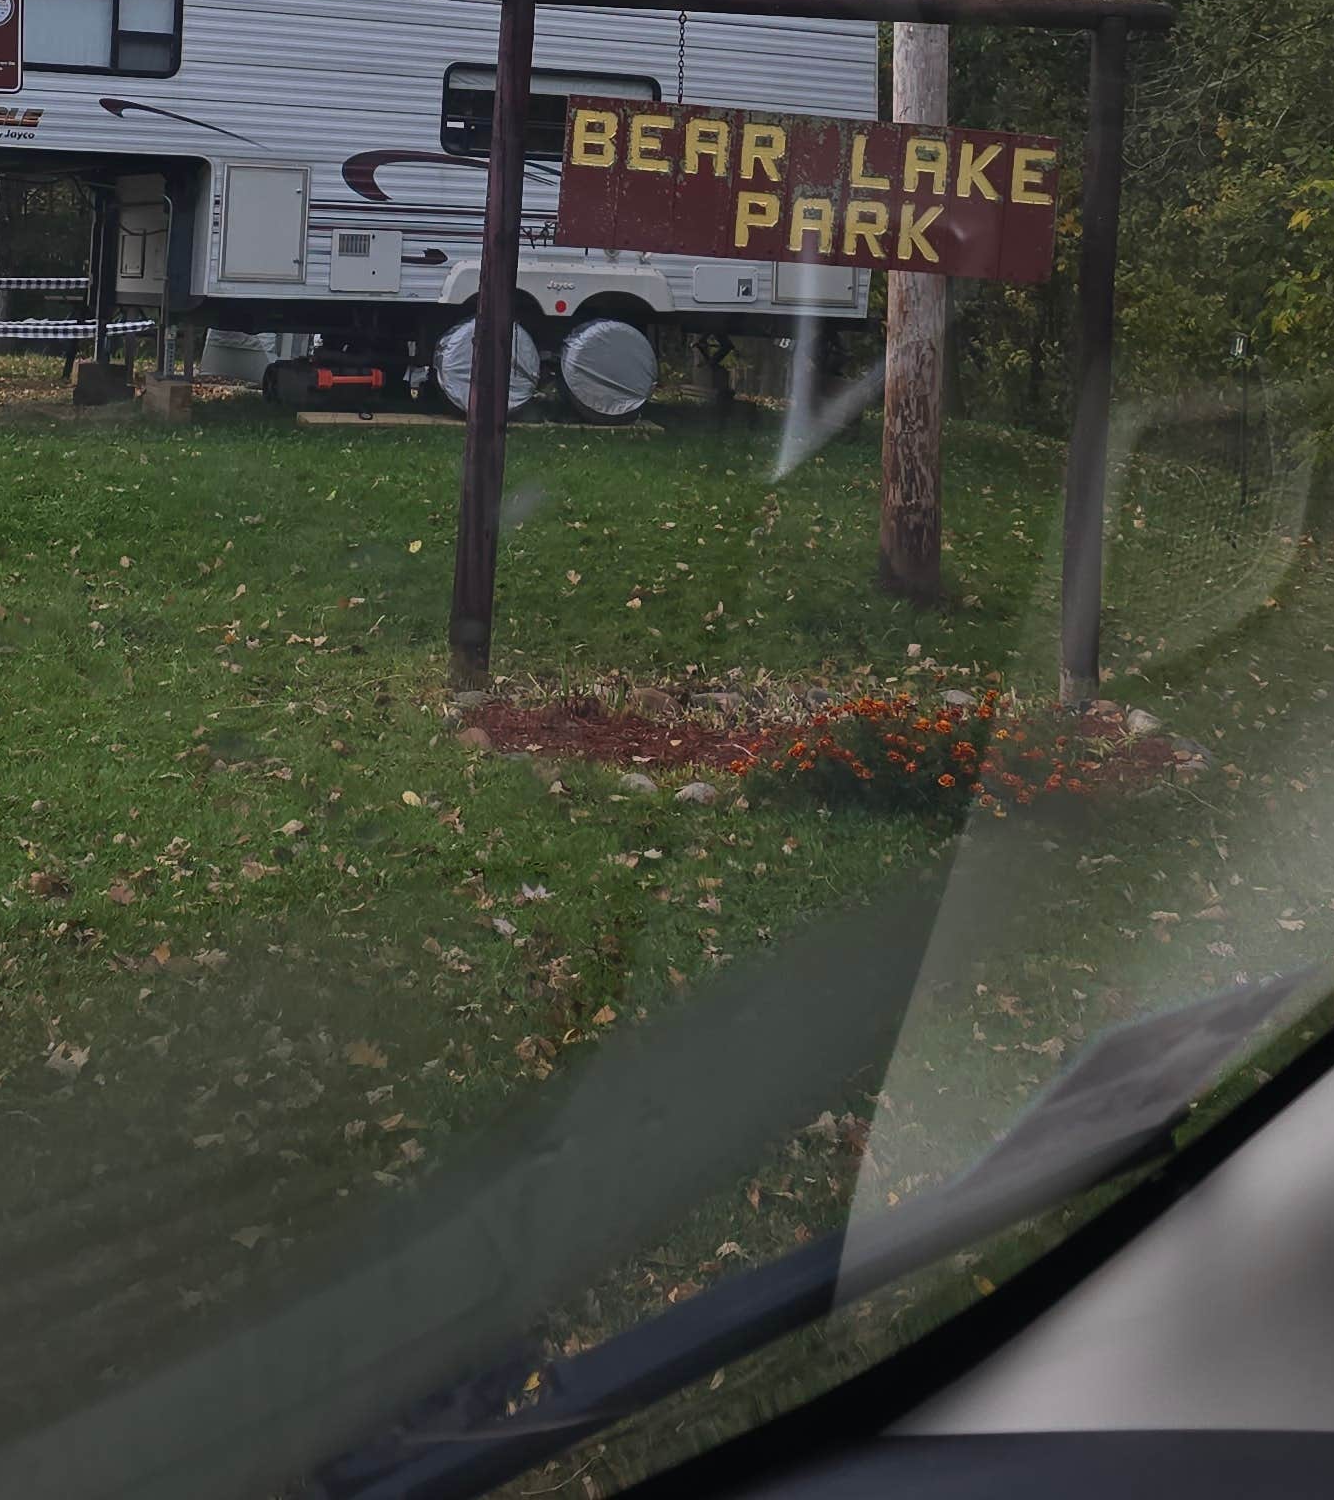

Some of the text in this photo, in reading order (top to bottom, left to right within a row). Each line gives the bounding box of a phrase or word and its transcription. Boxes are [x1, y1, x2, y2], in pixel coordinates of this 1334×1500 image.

[4, 129, 36, 140] Jayco
[570, 109, 1057, 205] BEAR LAKE
[734, 192, 944, 263] PARK
